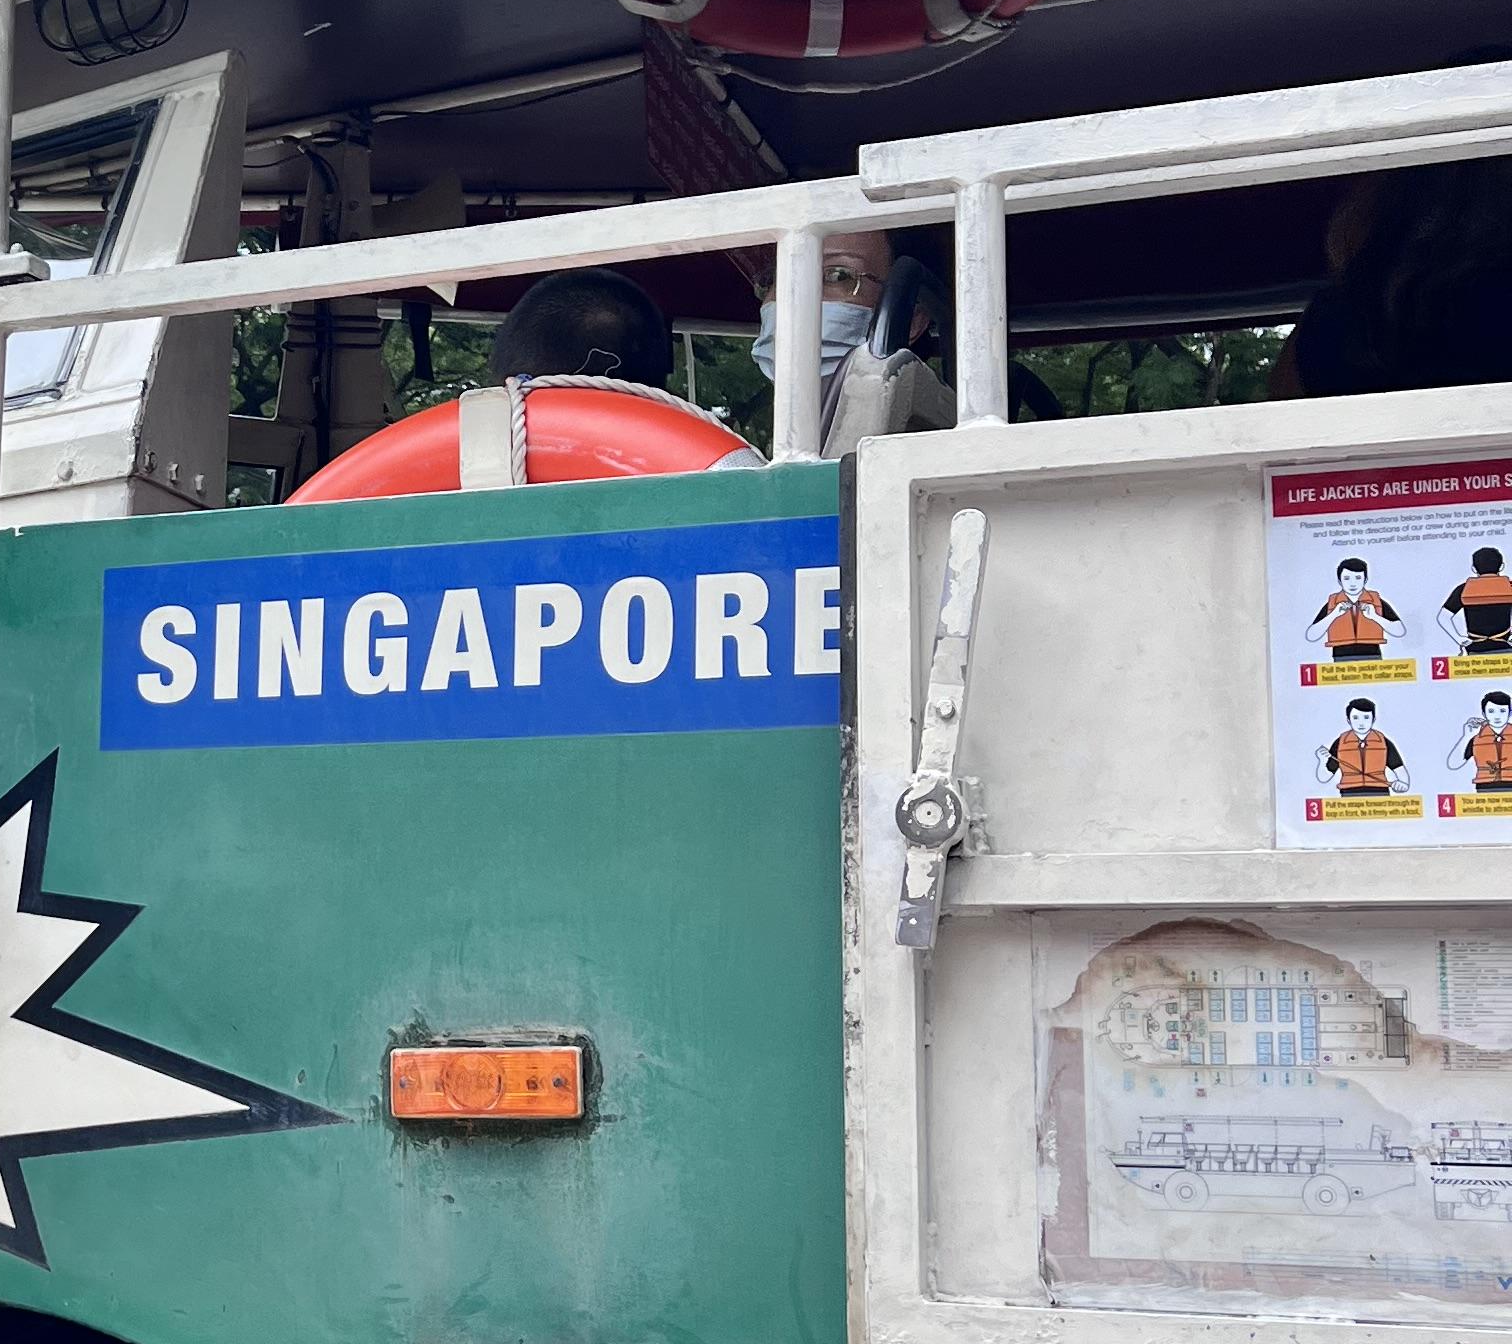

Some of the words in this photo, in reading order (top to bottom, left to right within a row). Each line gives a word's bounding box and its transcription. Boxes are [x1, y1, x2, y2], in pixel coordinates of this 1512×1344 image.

[1288, 488, 1316, 504] LIFE
[1319, 483, 1380, 501] JACKETS
[1382, 481, 1410, 496] ARE
[1413, 477, 1460, 494] UNDER
[1463, 474, 1501, 490] YOUR
[1313, 530, 1328, 538] and
[1351, 527, 1364, 535] the
[1468, 530, 1485, 538] your
[137, 566, 841, 705] SINGAPORE
[1304, 667, 1312, 683] 1
[1435, 660, 1445, 676] 2
[1309, 801, 1319, 818] 3
[1442, 797, 1451, 814] 4
